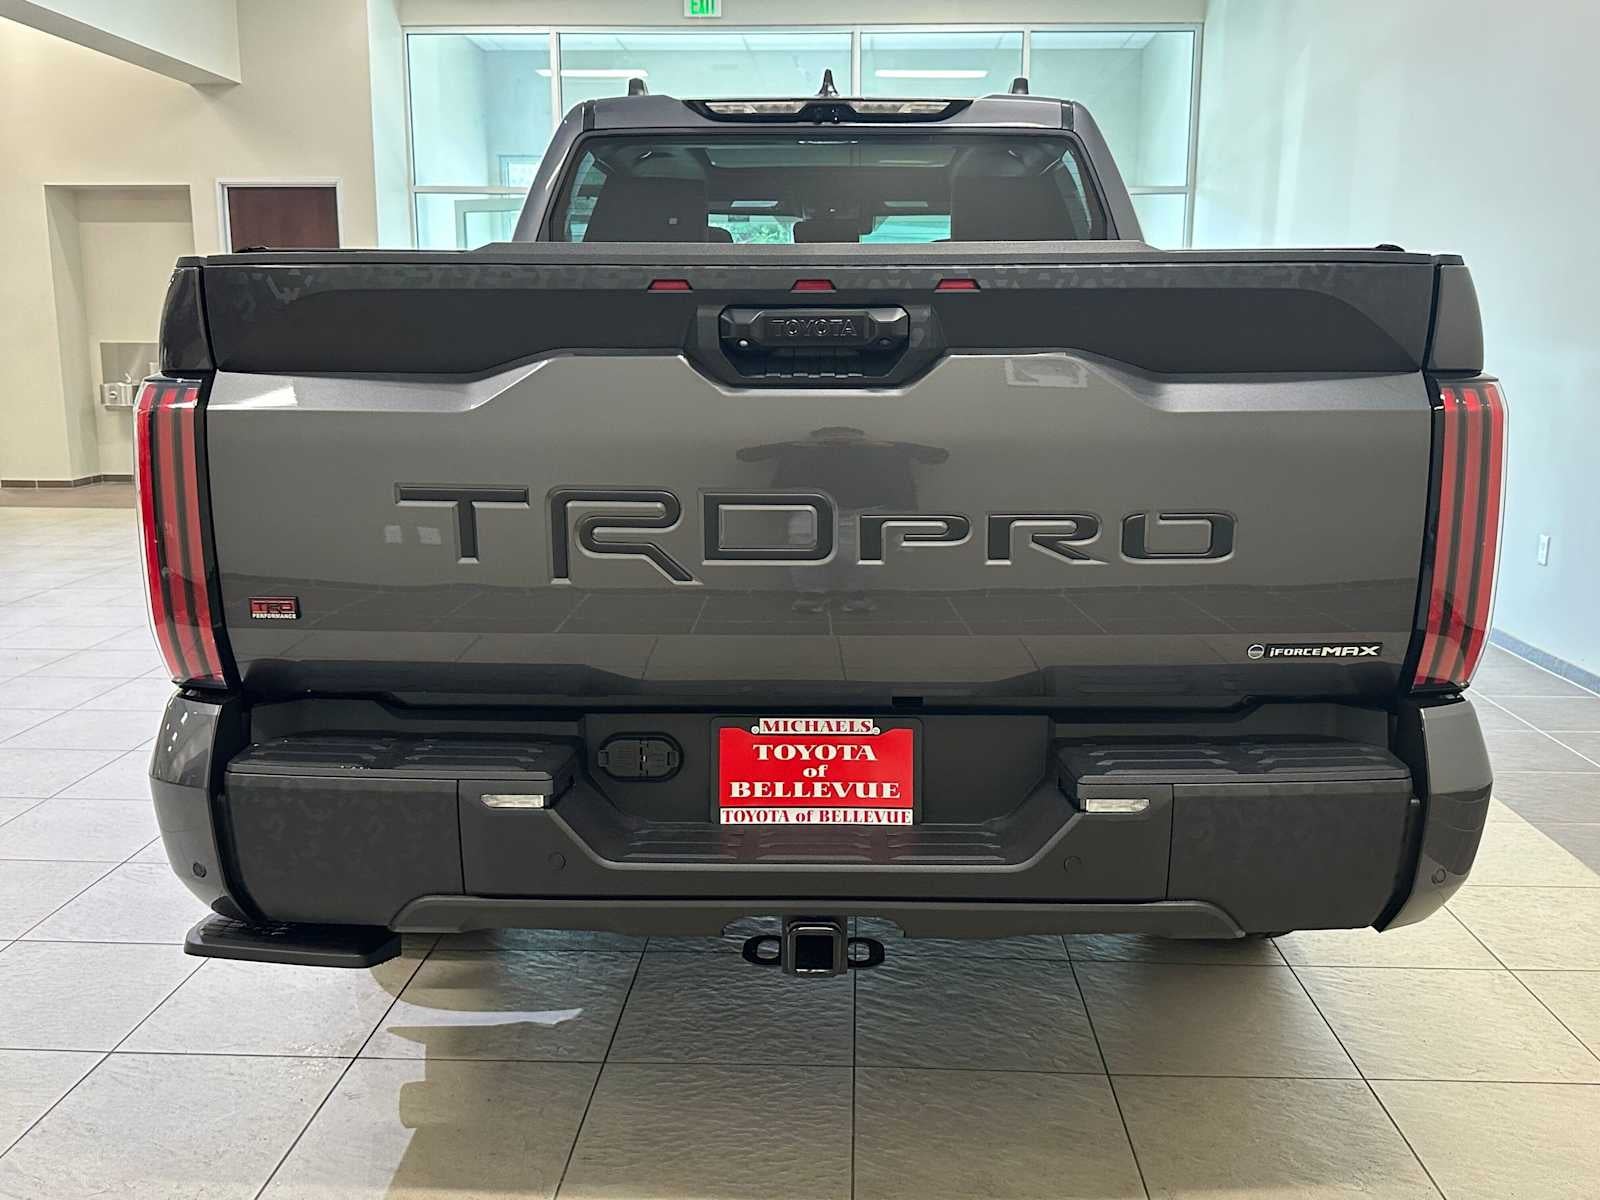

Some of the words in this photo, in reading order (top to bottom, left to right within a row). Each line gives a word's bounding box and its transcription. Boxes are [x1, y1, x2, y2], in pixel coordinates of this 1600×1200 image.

[772, 319, 857, 336] TOYOTA
[761, 719, 872, 733] MICHAELS
[752, 744, 878, 761] TOYOTA
[802, 764, 829, 778] of
[729, 781, 902, 799] BELLEVUE
[722, 809, 790, 823] TOYOTA
[795, 809, 814, 823] of
[819, 810, 911, 824] BELLEVUE
